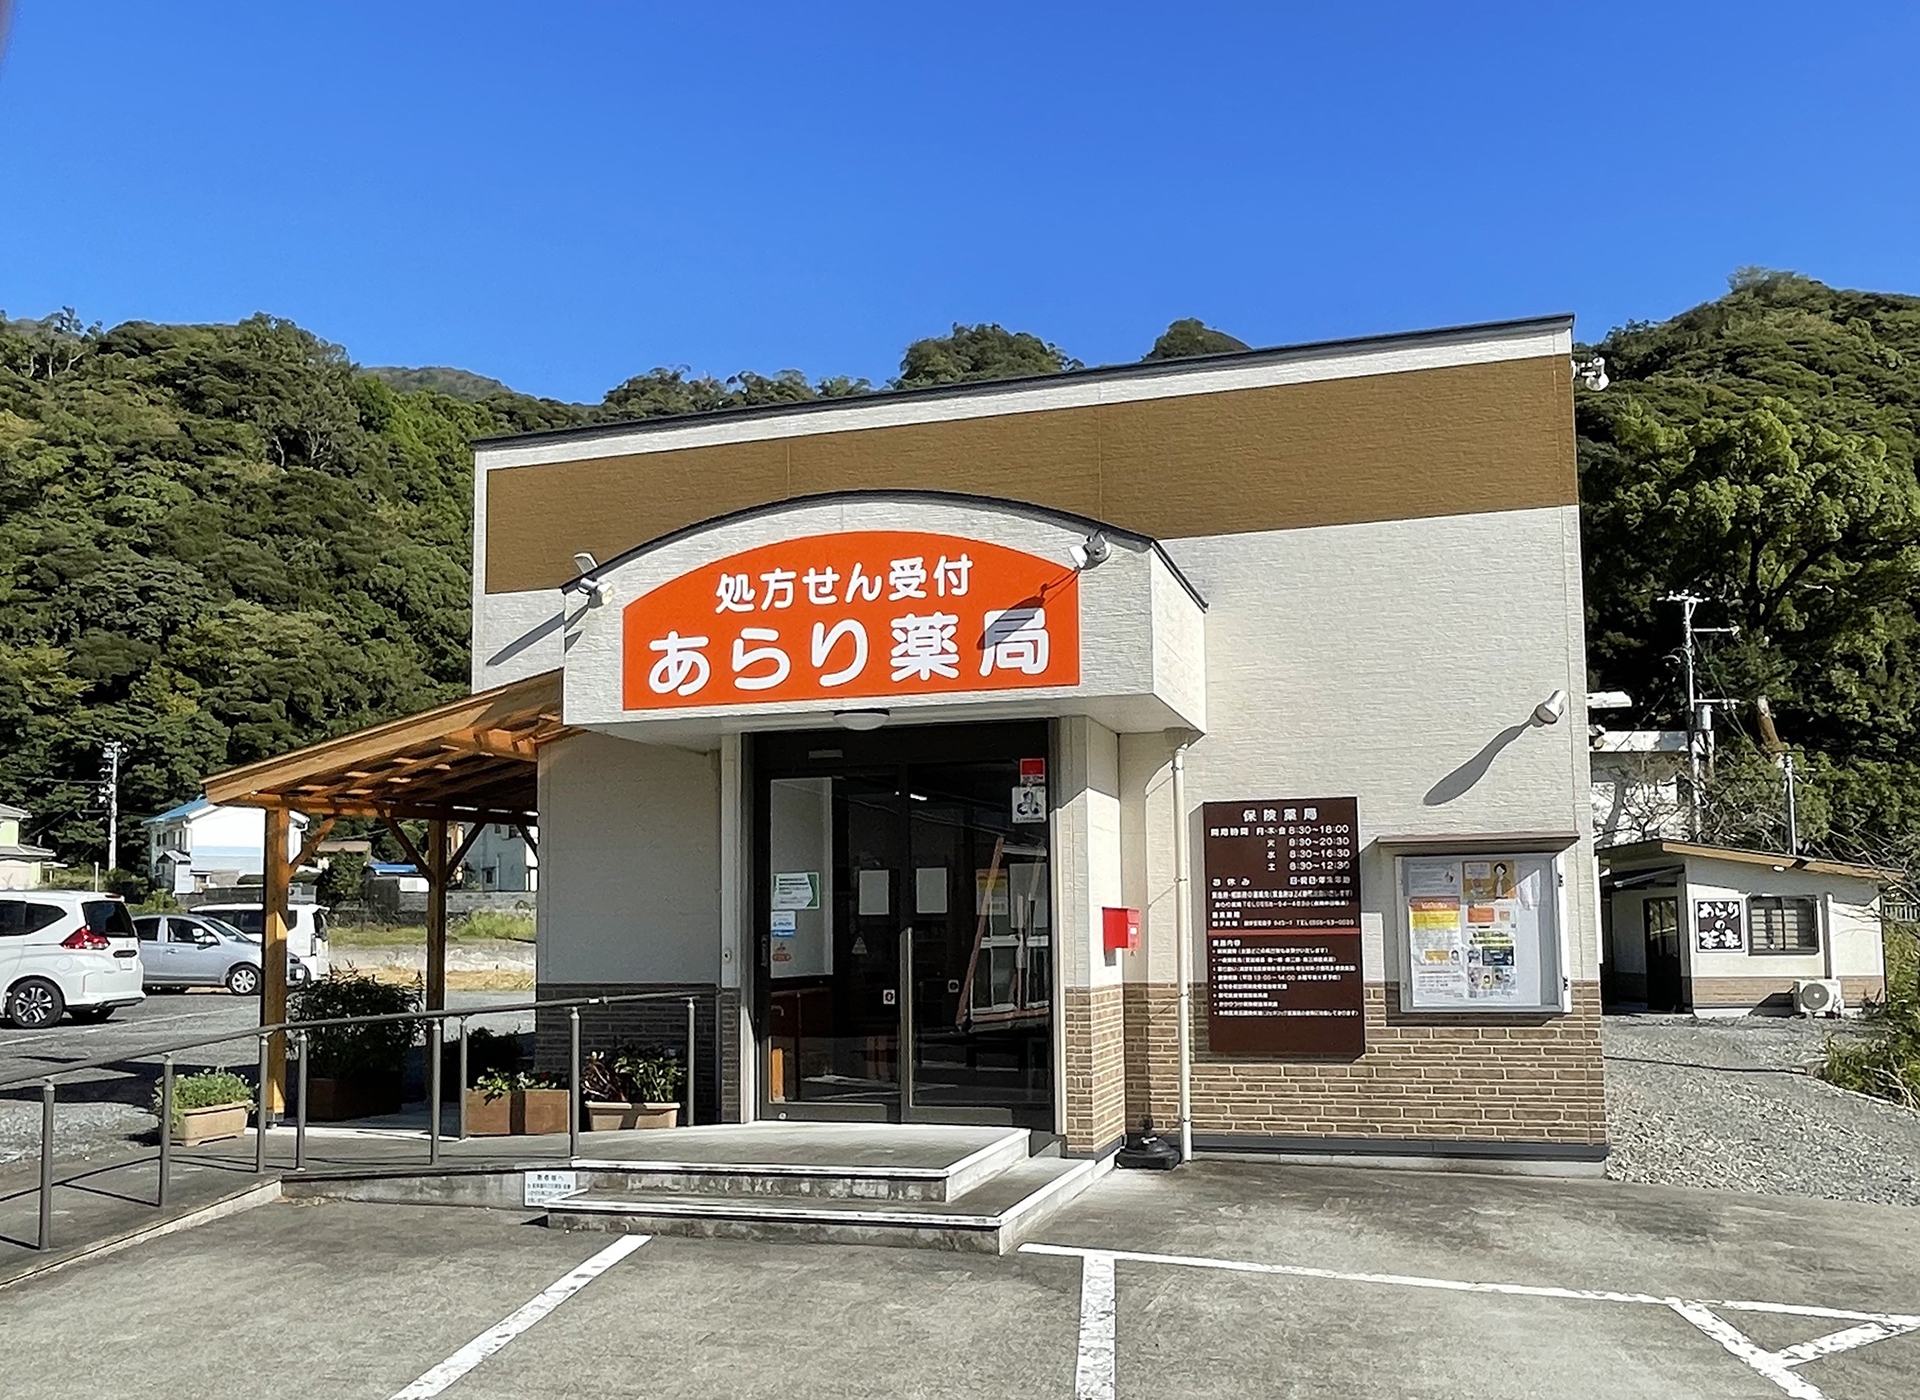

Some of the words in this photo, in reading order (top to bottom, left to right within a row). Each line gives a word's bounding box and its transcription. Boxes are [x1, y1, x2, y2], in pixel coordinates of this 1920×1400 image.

[715, 554, 973, 614] 処方せん受付
[648, 609, 1049, 696] あらり薬局
[1243, 808, 1317, 822] 保険薬局
[1715, 920, 1725, 929] の
